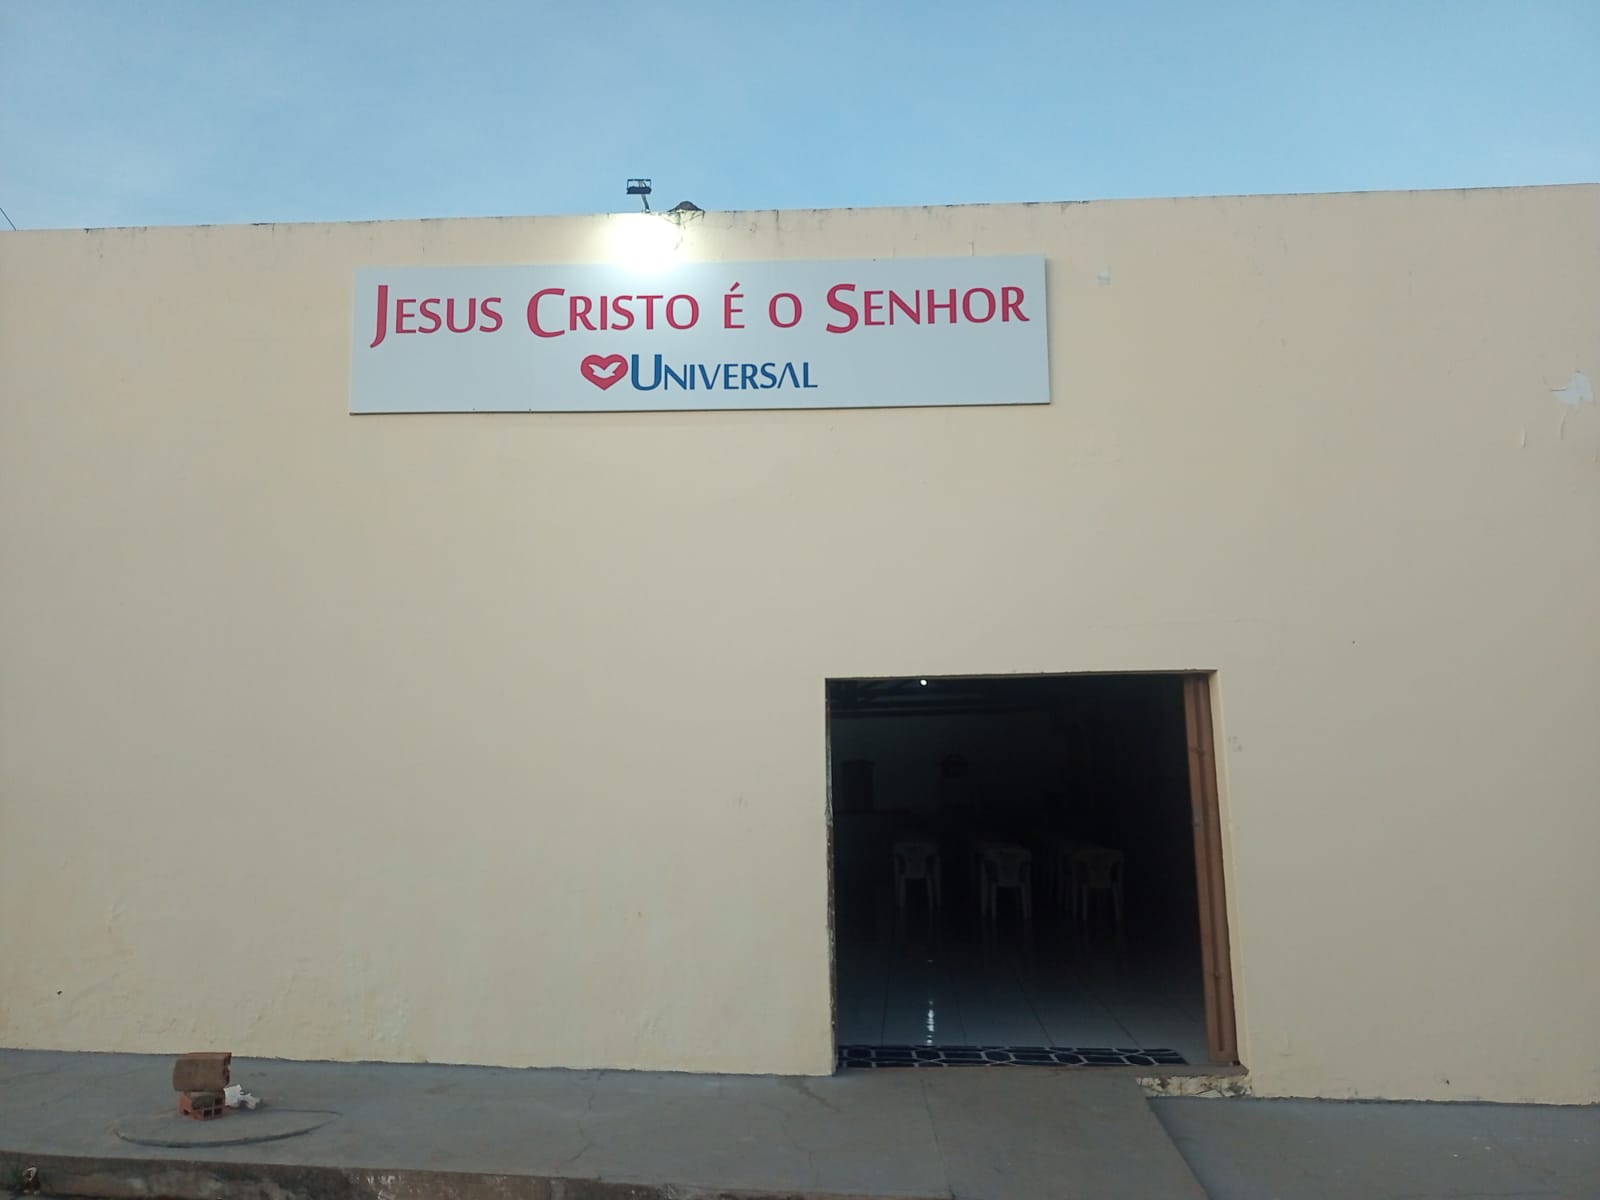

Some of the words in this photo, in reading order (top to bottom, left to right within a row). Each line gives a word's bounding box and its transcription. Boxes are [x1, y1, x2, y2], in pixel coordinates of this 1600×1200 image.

[370, 284, 503, 348] JESUS
[527, 287, 699, 338] CRISTO
[723, 281, 745, 329] É
[768, 292, 802, 328] O
[825, 283, 1030, 334] SENHOR
[631, 353, 818, 391] UNIVERSAL
